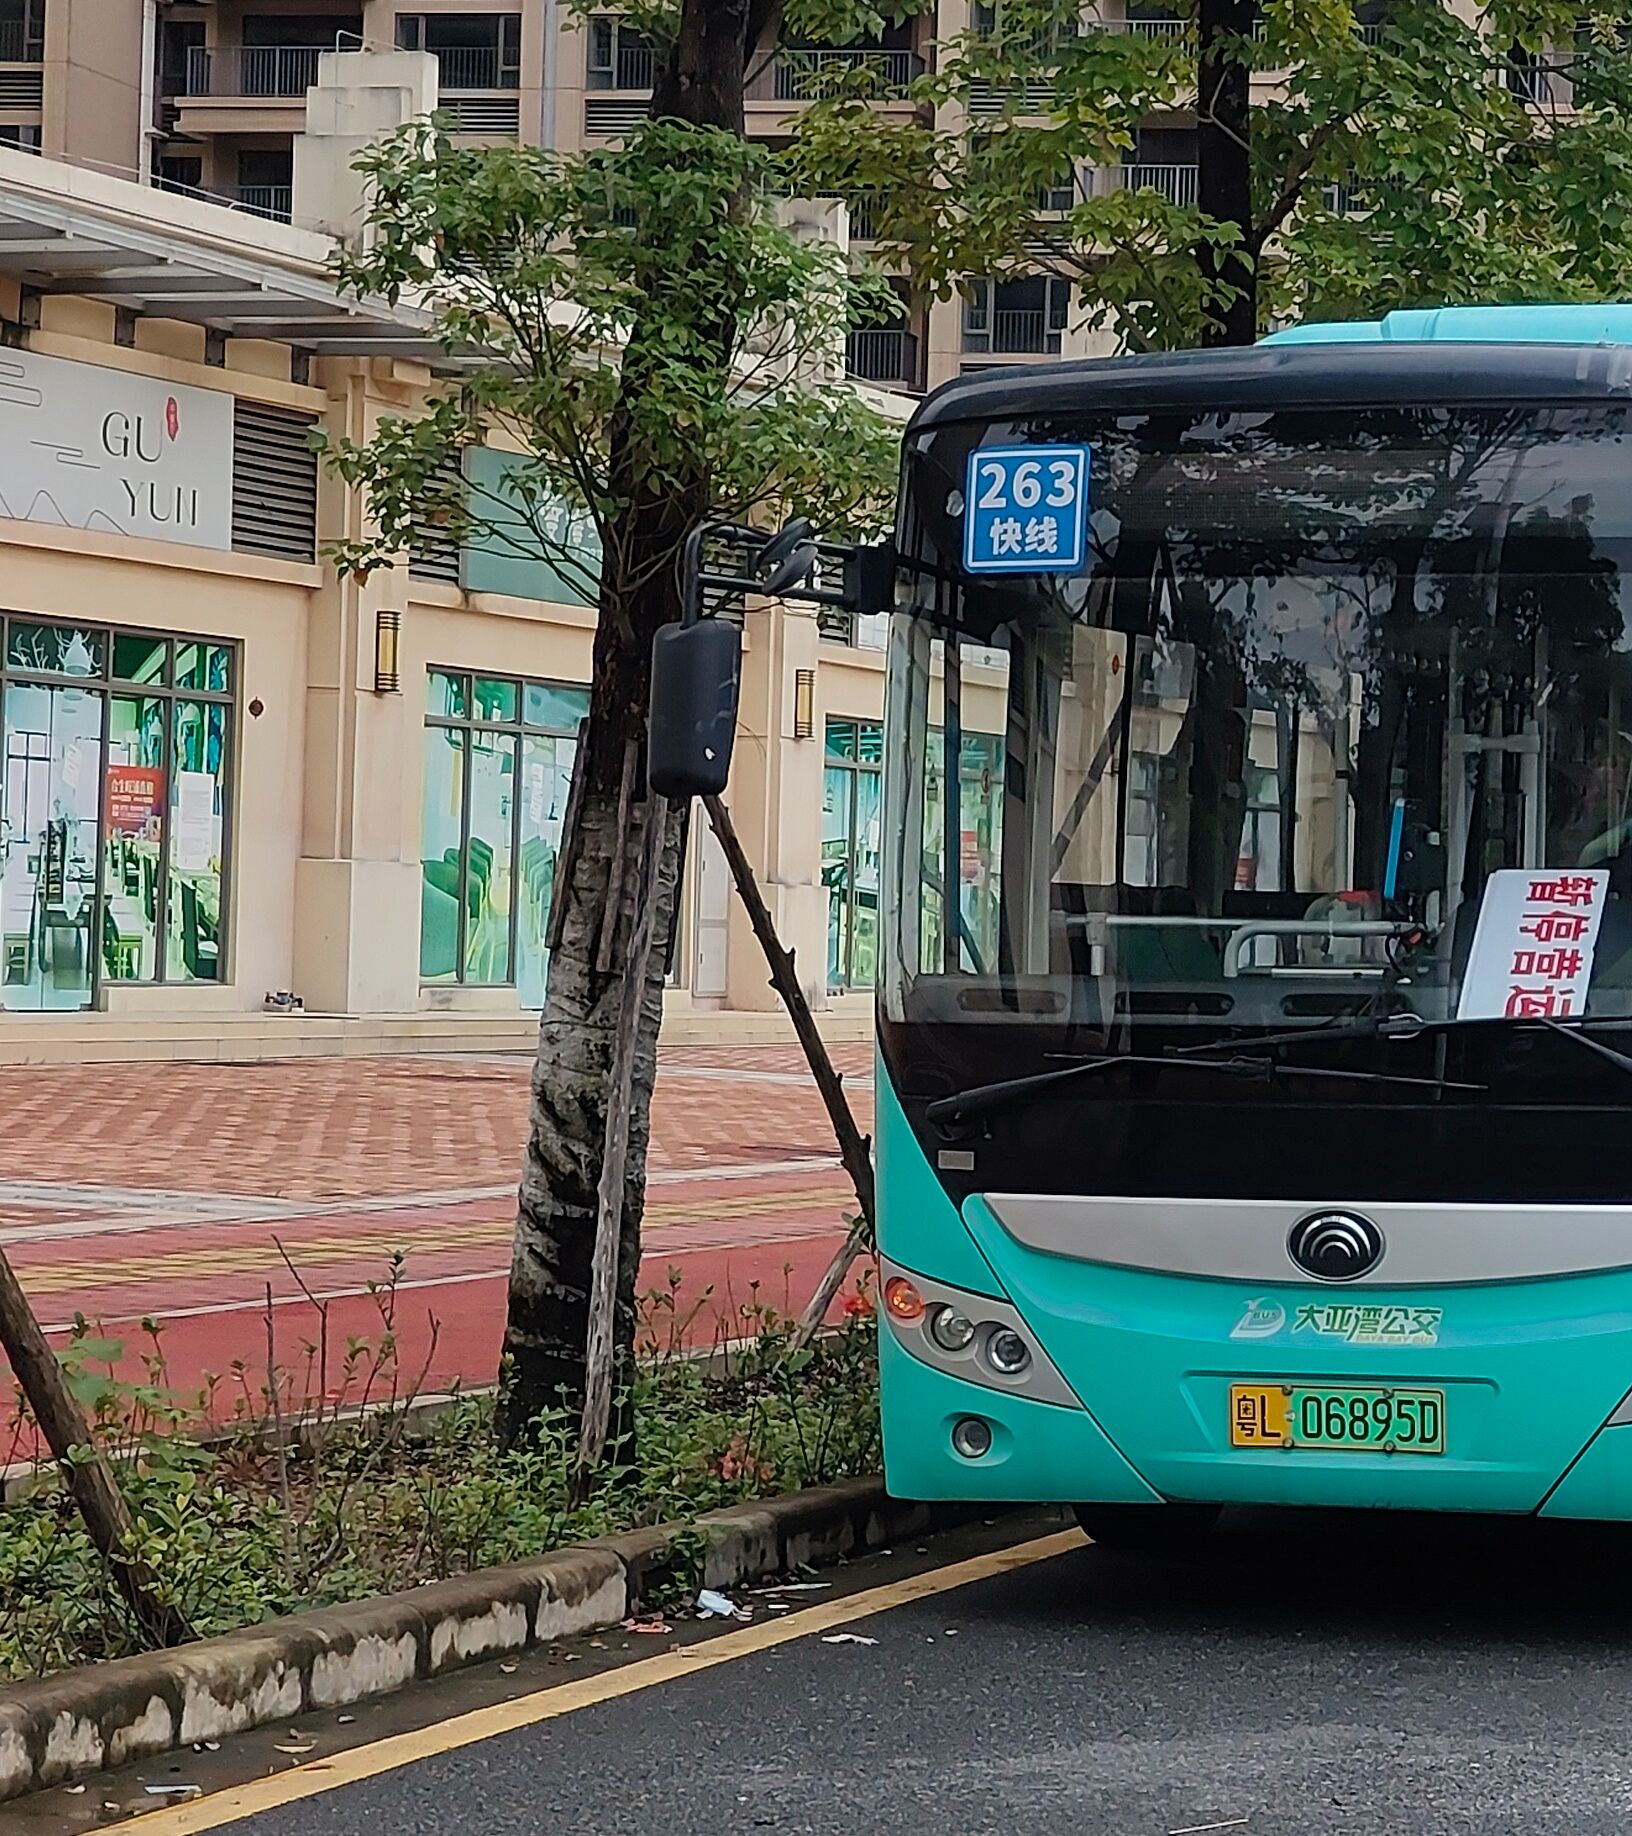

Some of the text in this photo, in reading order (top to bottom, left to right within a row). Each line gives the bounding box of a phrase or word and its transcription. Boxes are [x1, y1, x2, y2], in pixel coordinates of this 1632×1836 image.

[102, 411, 163, 462] GU
[120, 478, 197, 526] YUN
[979, 461, 1075, 508] 263
[990, 516, 1058, 555] 快线
[1505, 877, 1598, 1017] 暂停营运
[1253, 1311, 1279, 1320] BUS
[1295, 1305, 1441, 1340] 大亚湾公交
[1301, 1396, 1438, 1443] 06895D
